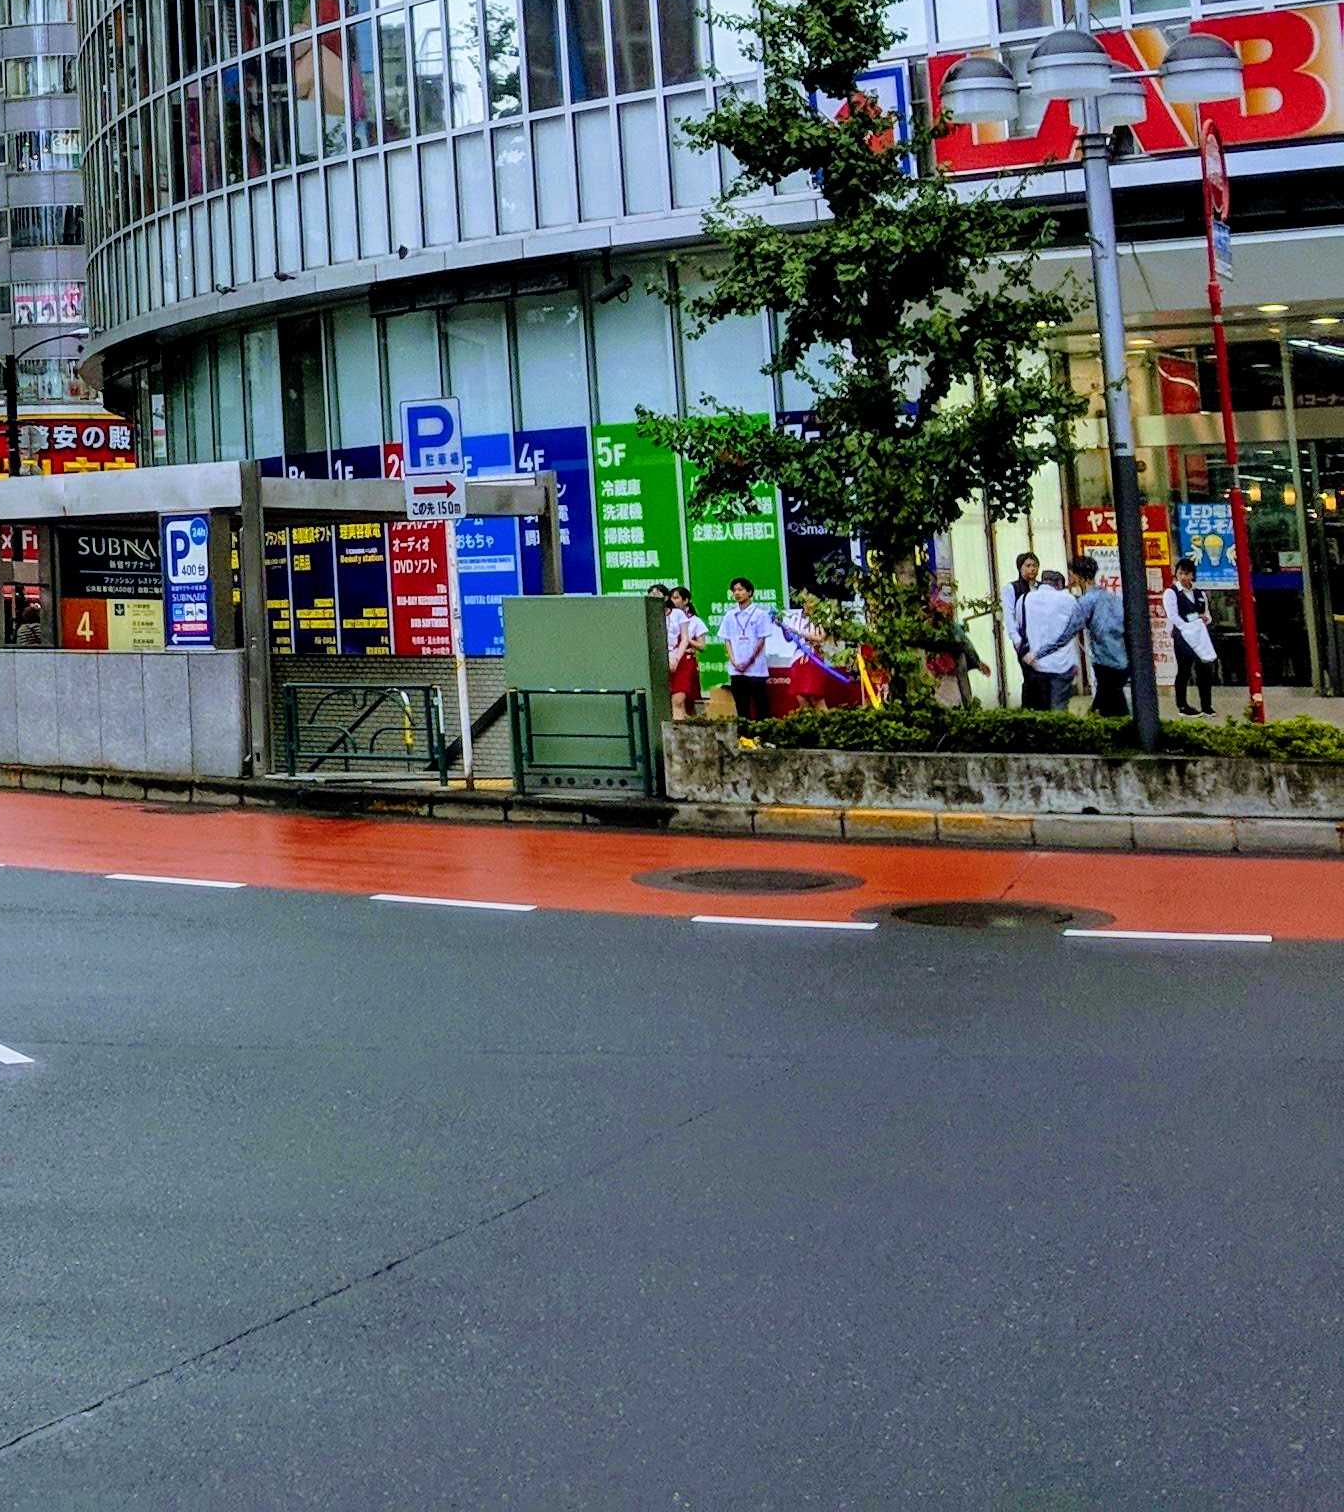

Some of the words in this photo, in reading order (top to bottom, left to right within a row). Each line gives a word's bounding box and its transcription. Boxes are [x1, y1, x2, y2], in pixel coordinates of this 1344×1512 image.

[407, 405, 454, 468] P
[426, 454, 459, 467] 駐車場
[519, 443, 544, 472] 4F
[597, 437, 626, 467] 5F
[601, 479, 641, 497] 冷蔵庫
[413, 502, 435, 515] この先
[603, 502, 643, 521] 洗濯機
[192, 528, 205, 538] 24h
[604, 526, 644, 545] 掃除機
[693, 522, 775, 541] 企業法人専用窓口
[170, 530, 190, 577] P
[393, 537, 429, 553] オーディオ
[394, 559, 412, 574] DVD
[414, 558, 437, 574] ソフト
[606, 550, 659, 568] 照明器具
[77, 610, 94, 643] 4
